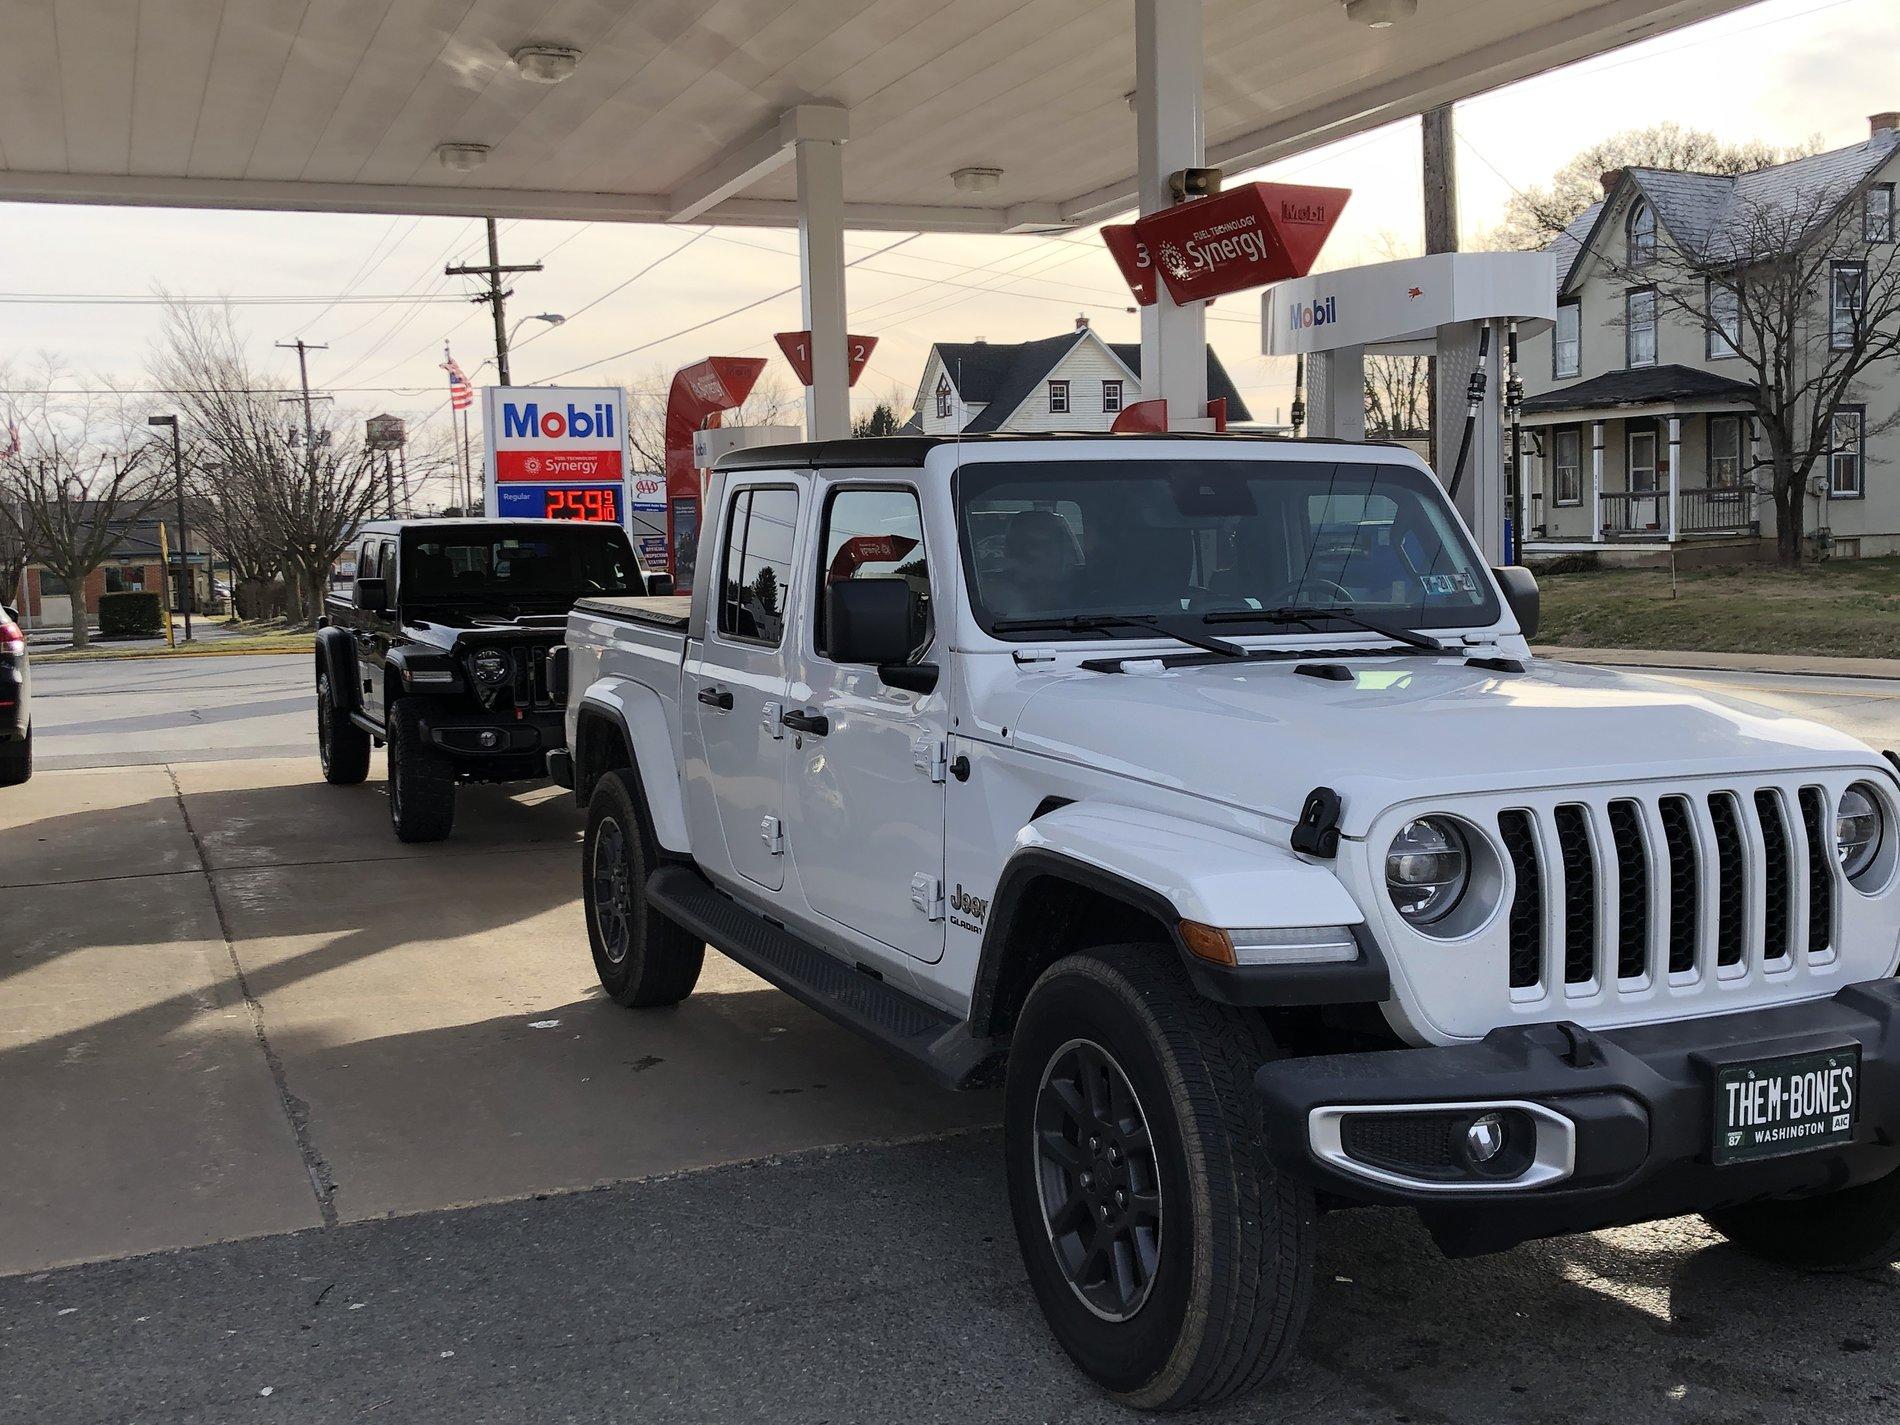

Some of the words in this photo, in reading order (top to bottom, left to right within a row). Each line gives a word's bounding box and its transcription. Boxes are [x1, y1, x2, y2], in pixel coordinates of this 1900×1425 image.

[1193, 231, 1211, 241] FUEL
[1211, 214, 1257, 236] TECHNOLOGY
[1136, 243, 1151, 268] 3
[1185, 229, 1267, 272] Synergy
[1290, 296, 1336, 330] Mobil
[796, 344, 806, 361] 1
[853, 345, 865, 362] 2
[503, 403, 614, 438] Mobil
[545, 459, 598, 474] Synergy
[503, 493, 531, 502] Regular
[1726, 1066, 1853, 1127] THEM-BONES
[1728, 1136, 1741, 1147] 87
[1754, 1121, 1825, 1143] WASHINGTON
